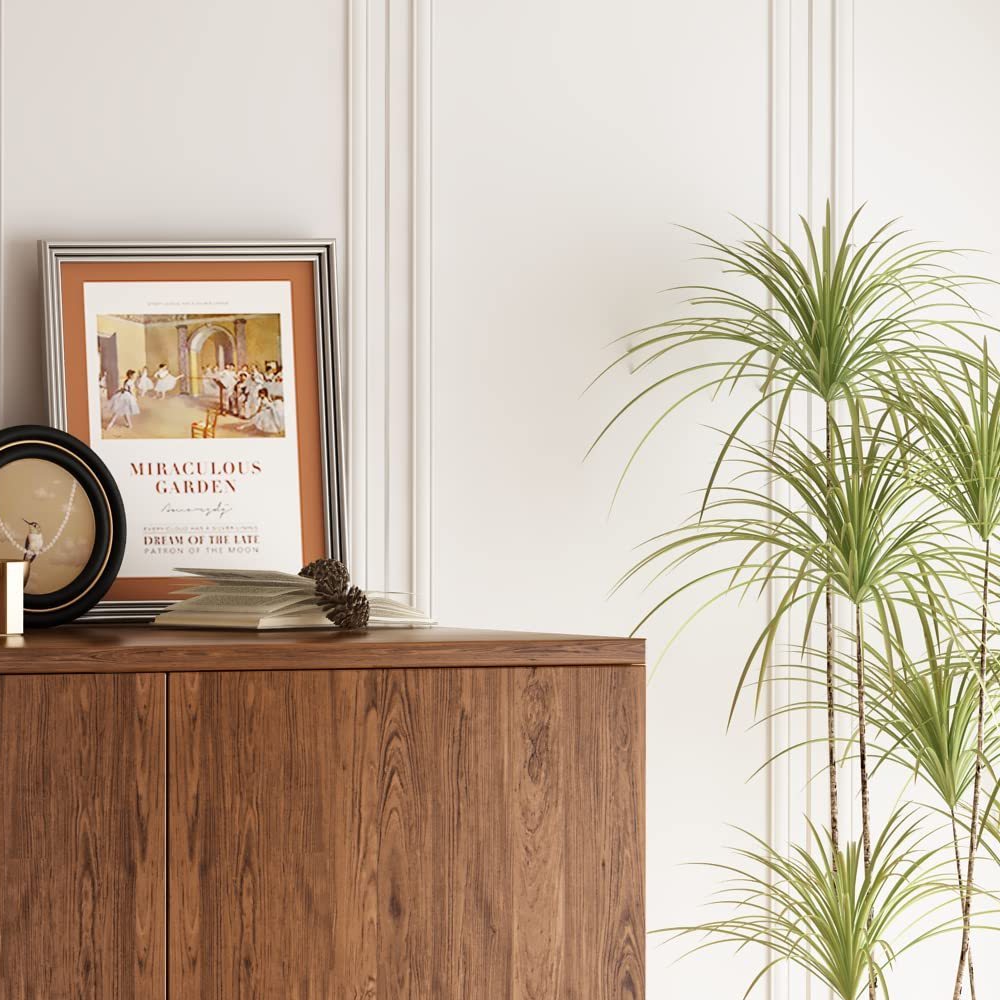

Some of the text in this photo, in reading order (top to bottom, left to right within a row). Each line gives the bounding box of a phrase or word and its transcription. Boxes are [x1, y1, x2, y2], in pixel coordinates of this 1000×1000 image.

[130, 461, 262, 476] MIRACULOUS
[155, 479, 237, 494] GARDEN
[143, 535, 260, 546] DREAM OF THE LATE
[144, 546, 260, 555] PATRON OF THE MOON
